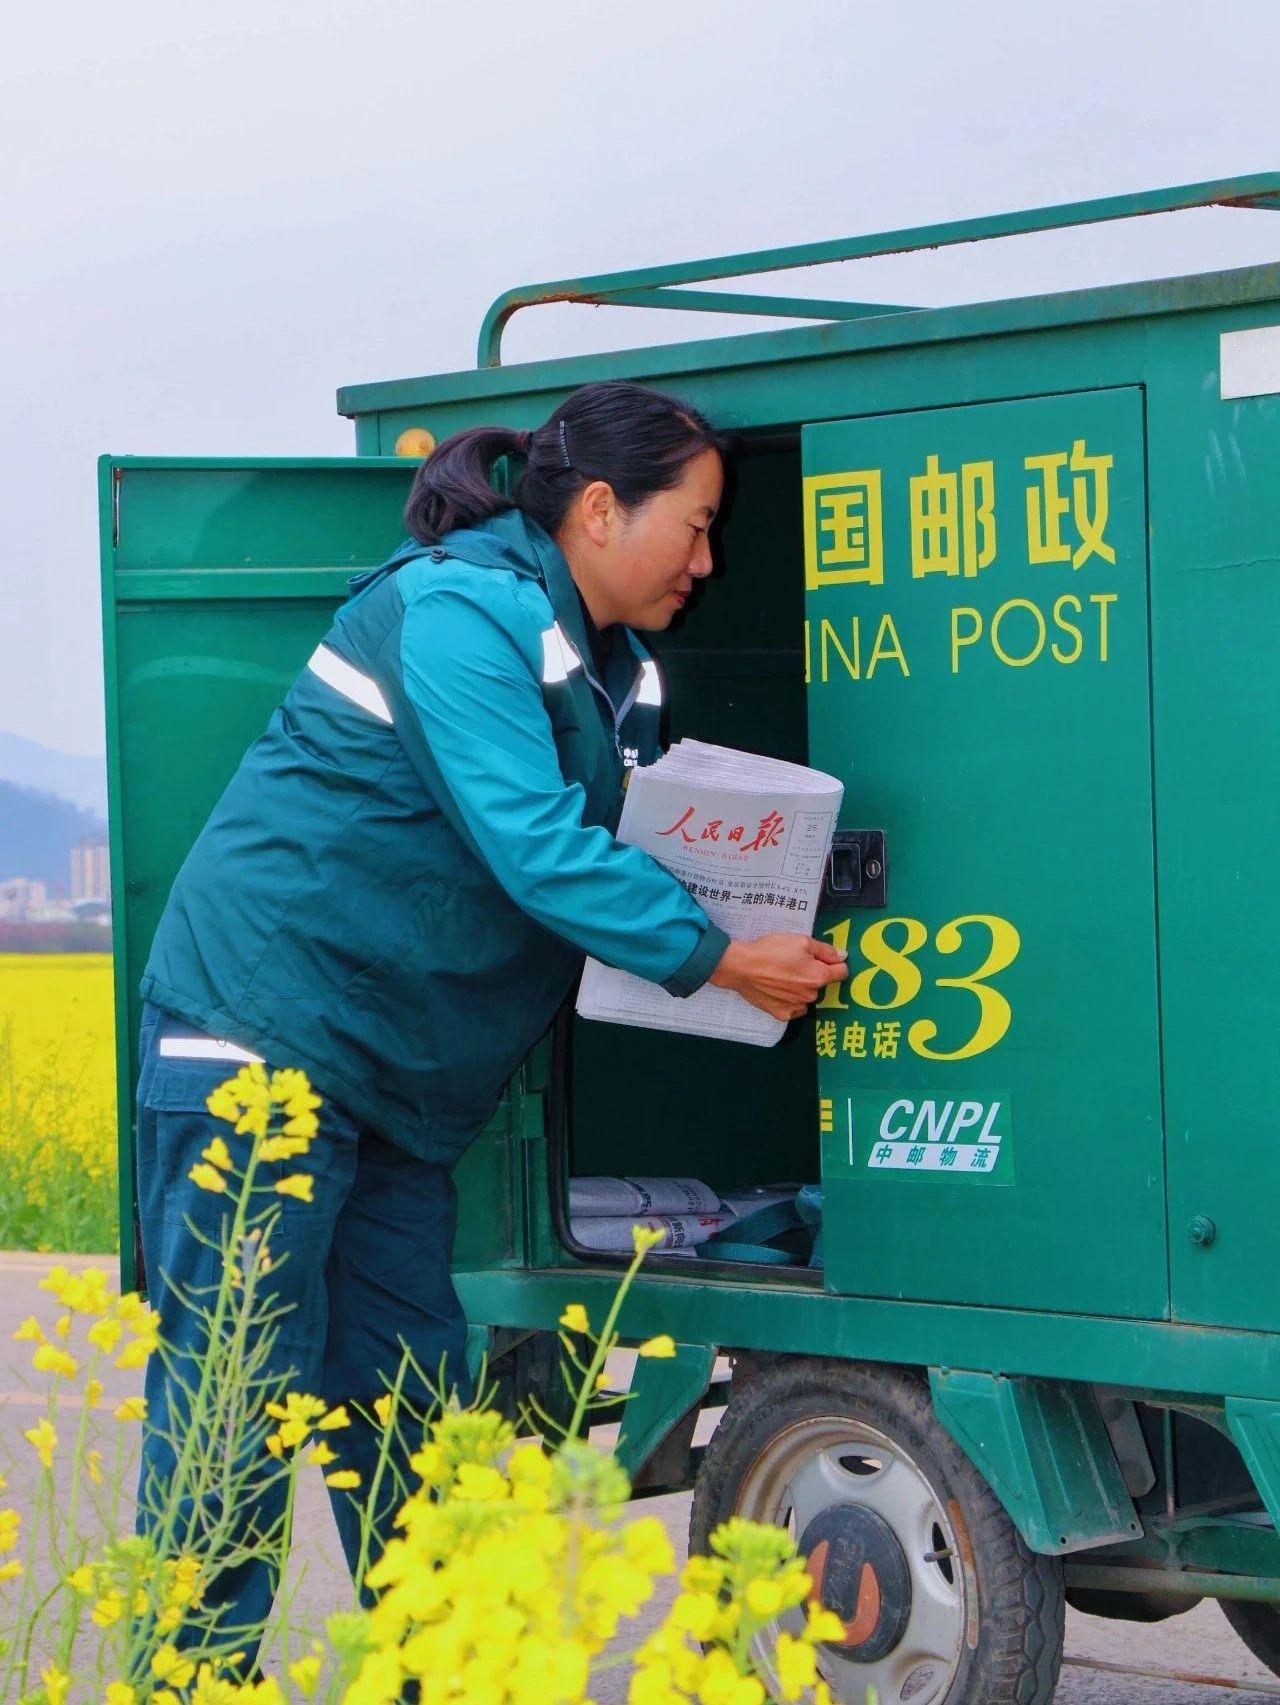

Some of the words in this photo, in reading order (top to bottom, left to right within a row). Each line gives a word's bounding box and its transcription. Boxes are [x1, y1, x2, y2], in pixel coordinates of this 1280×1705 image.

[803, 439, 1117, 591] 国邮政
[951, 593, 1118, 674] POST
[807, 824, 818, 832] 25
[816, 1020, 902, 1059] 线电话
[879, 1099, 1003, 1143] CNPL
[875, 1144, 992, 1168] 中邮物流
